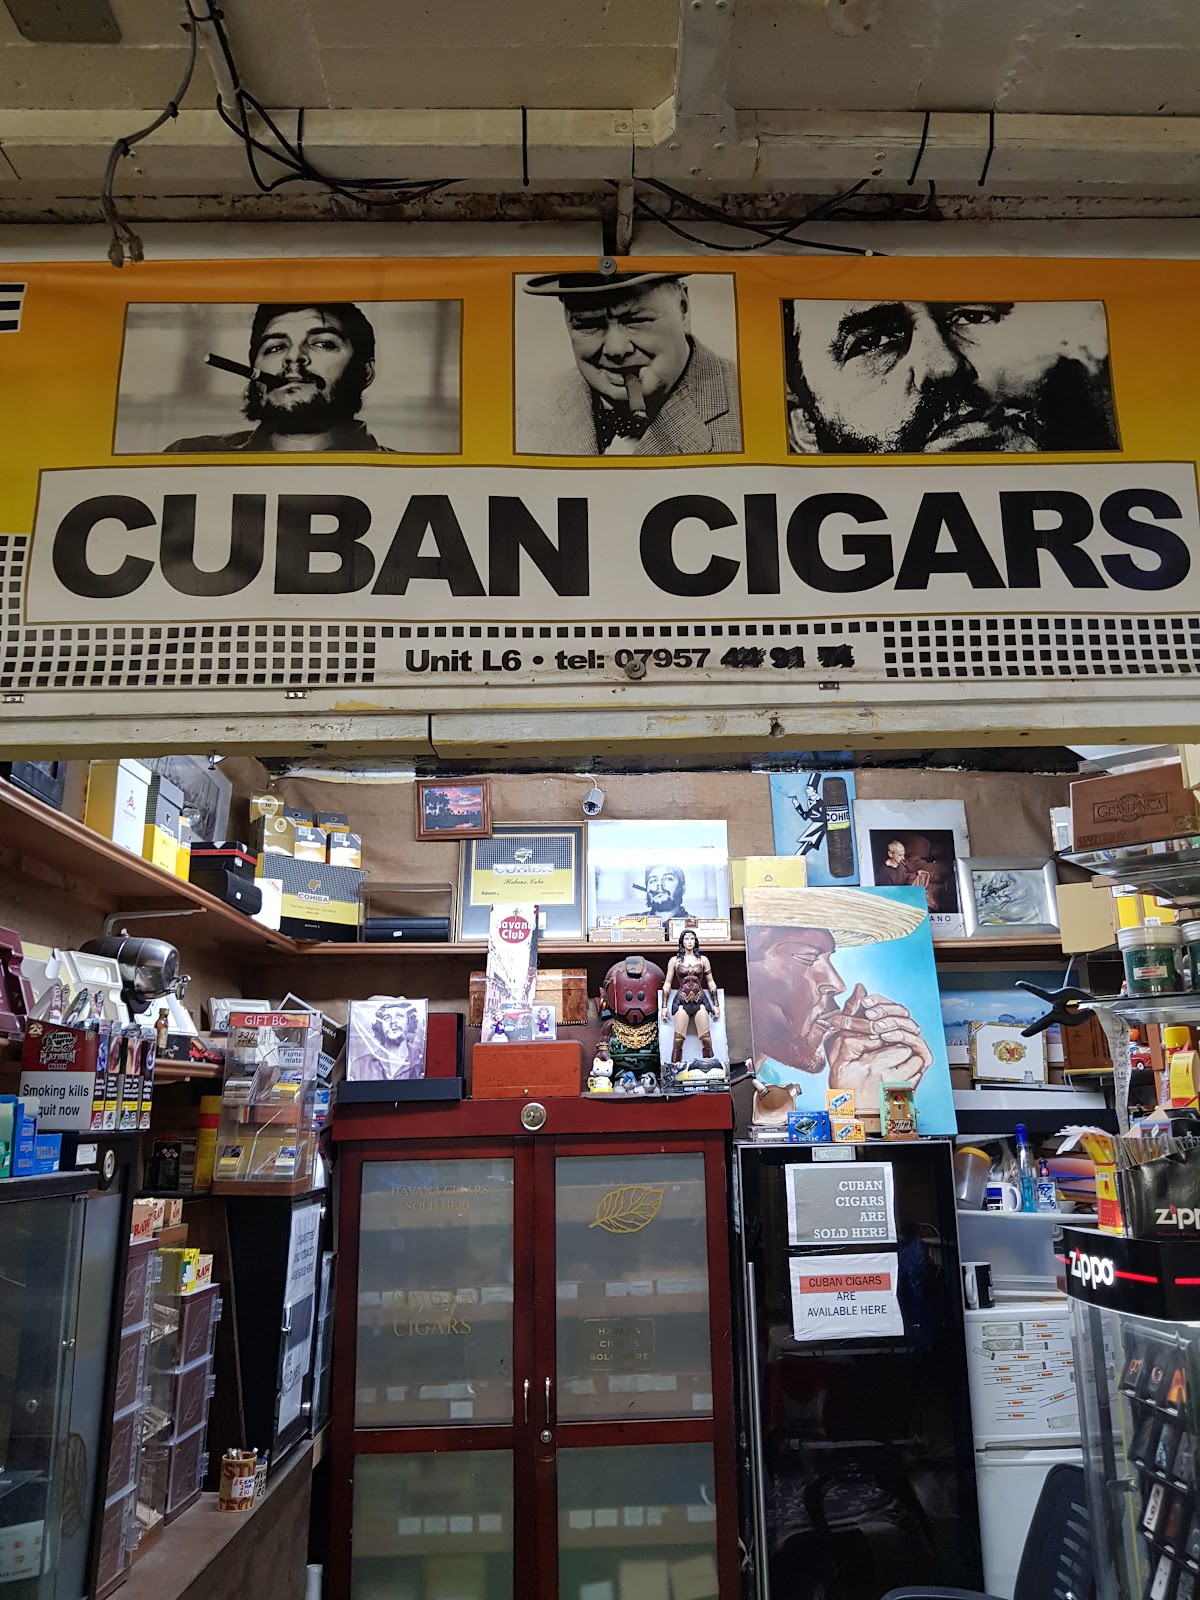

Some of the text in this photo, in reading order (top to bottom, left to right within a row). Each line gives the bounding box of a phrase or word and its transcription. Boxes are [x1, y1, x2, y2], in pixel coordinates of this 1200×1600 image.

[52, 488, 1192, 599] CUBAN CIGARS
[405, 649, 472, 672] Unit
[482, 649, 522, 672] L6
[554, 649, 605, 670] tel:
[614, 647, 711, 669] 07957
[1097, 799, 1164, 818] GRAND NICA
[298, 893, 329, 903] COHIBA
[501, 929, 525, 940] Club
[244, 1015, 270, 1026] GIFT
[22, 1084, 66, 1100] Smoking
[68, 1085, 90, 1098] kills
[38, 1103, 81, 1117] quit now
[391, 1185, 441, 1197] HAVANA
[838, 1180, 884, 1192] CUBAN
[406, 1200, 473, 1213] SOLD HERE
[835, 1196, 885, 1207] CIGARS
[859, 1211, 886, 1222] ARE
[133, 1217, 152, 1236] RAW
[813, 1227, 887, 1239] SOLD HERE
[195, 1263, 212, 1280] RAW
[808, 1275, 882, 1288] CUBAN CIGARS
[836, 1291, 857, 1301] ARE
[807, 1304, 888, 1317] AVAILABLE HERE
[393, 1316, 472, 1337] CIGARS
